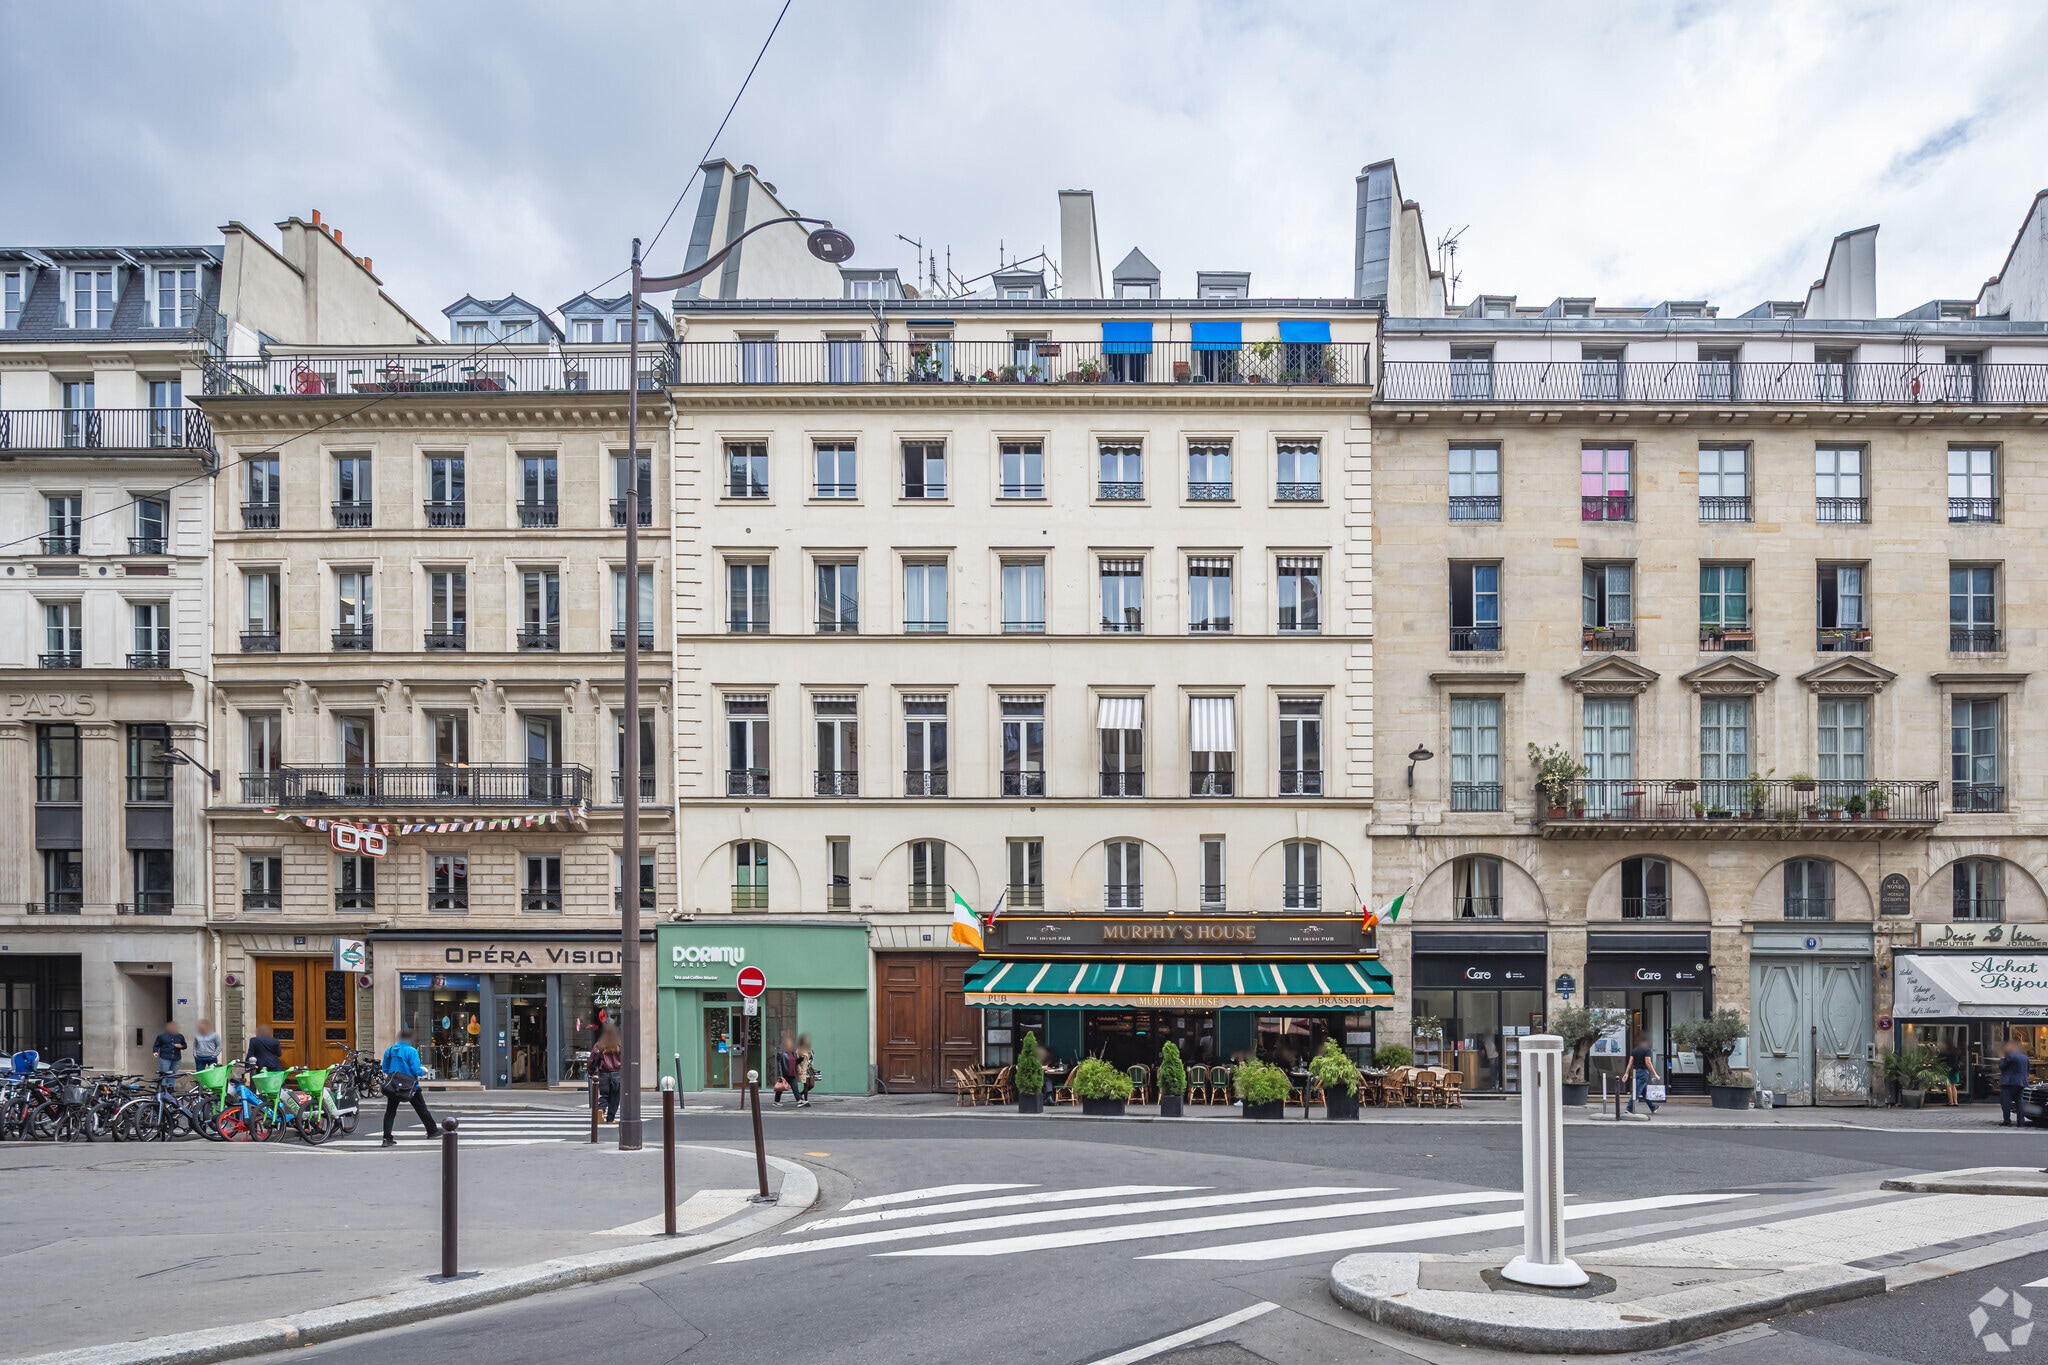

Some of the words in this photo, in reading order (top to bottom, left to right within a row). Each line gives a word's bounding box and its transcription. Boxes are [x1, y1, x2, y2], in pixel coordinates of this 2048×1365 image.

[6, 693, 96, 716] PARIS
[1102, 925, 1193, 940] MURPHY'S
[1198, 925, 1257, 939] HOUSE
[1935, 925, 1976, 942] Denis
[445, 944, 533, 964] OPÉRA
[1970, 957, 2038, 974] Achat
[987, 994, 1007, 1002] PUB
[1139, 997, 1186, 1006] MURPHY'S
[1188, 997, 1220, 1006] HOUSE
[1317, 996, 1372, 1004] BRASSERIE
[2018, 1006, 2041, 1016] Denis
